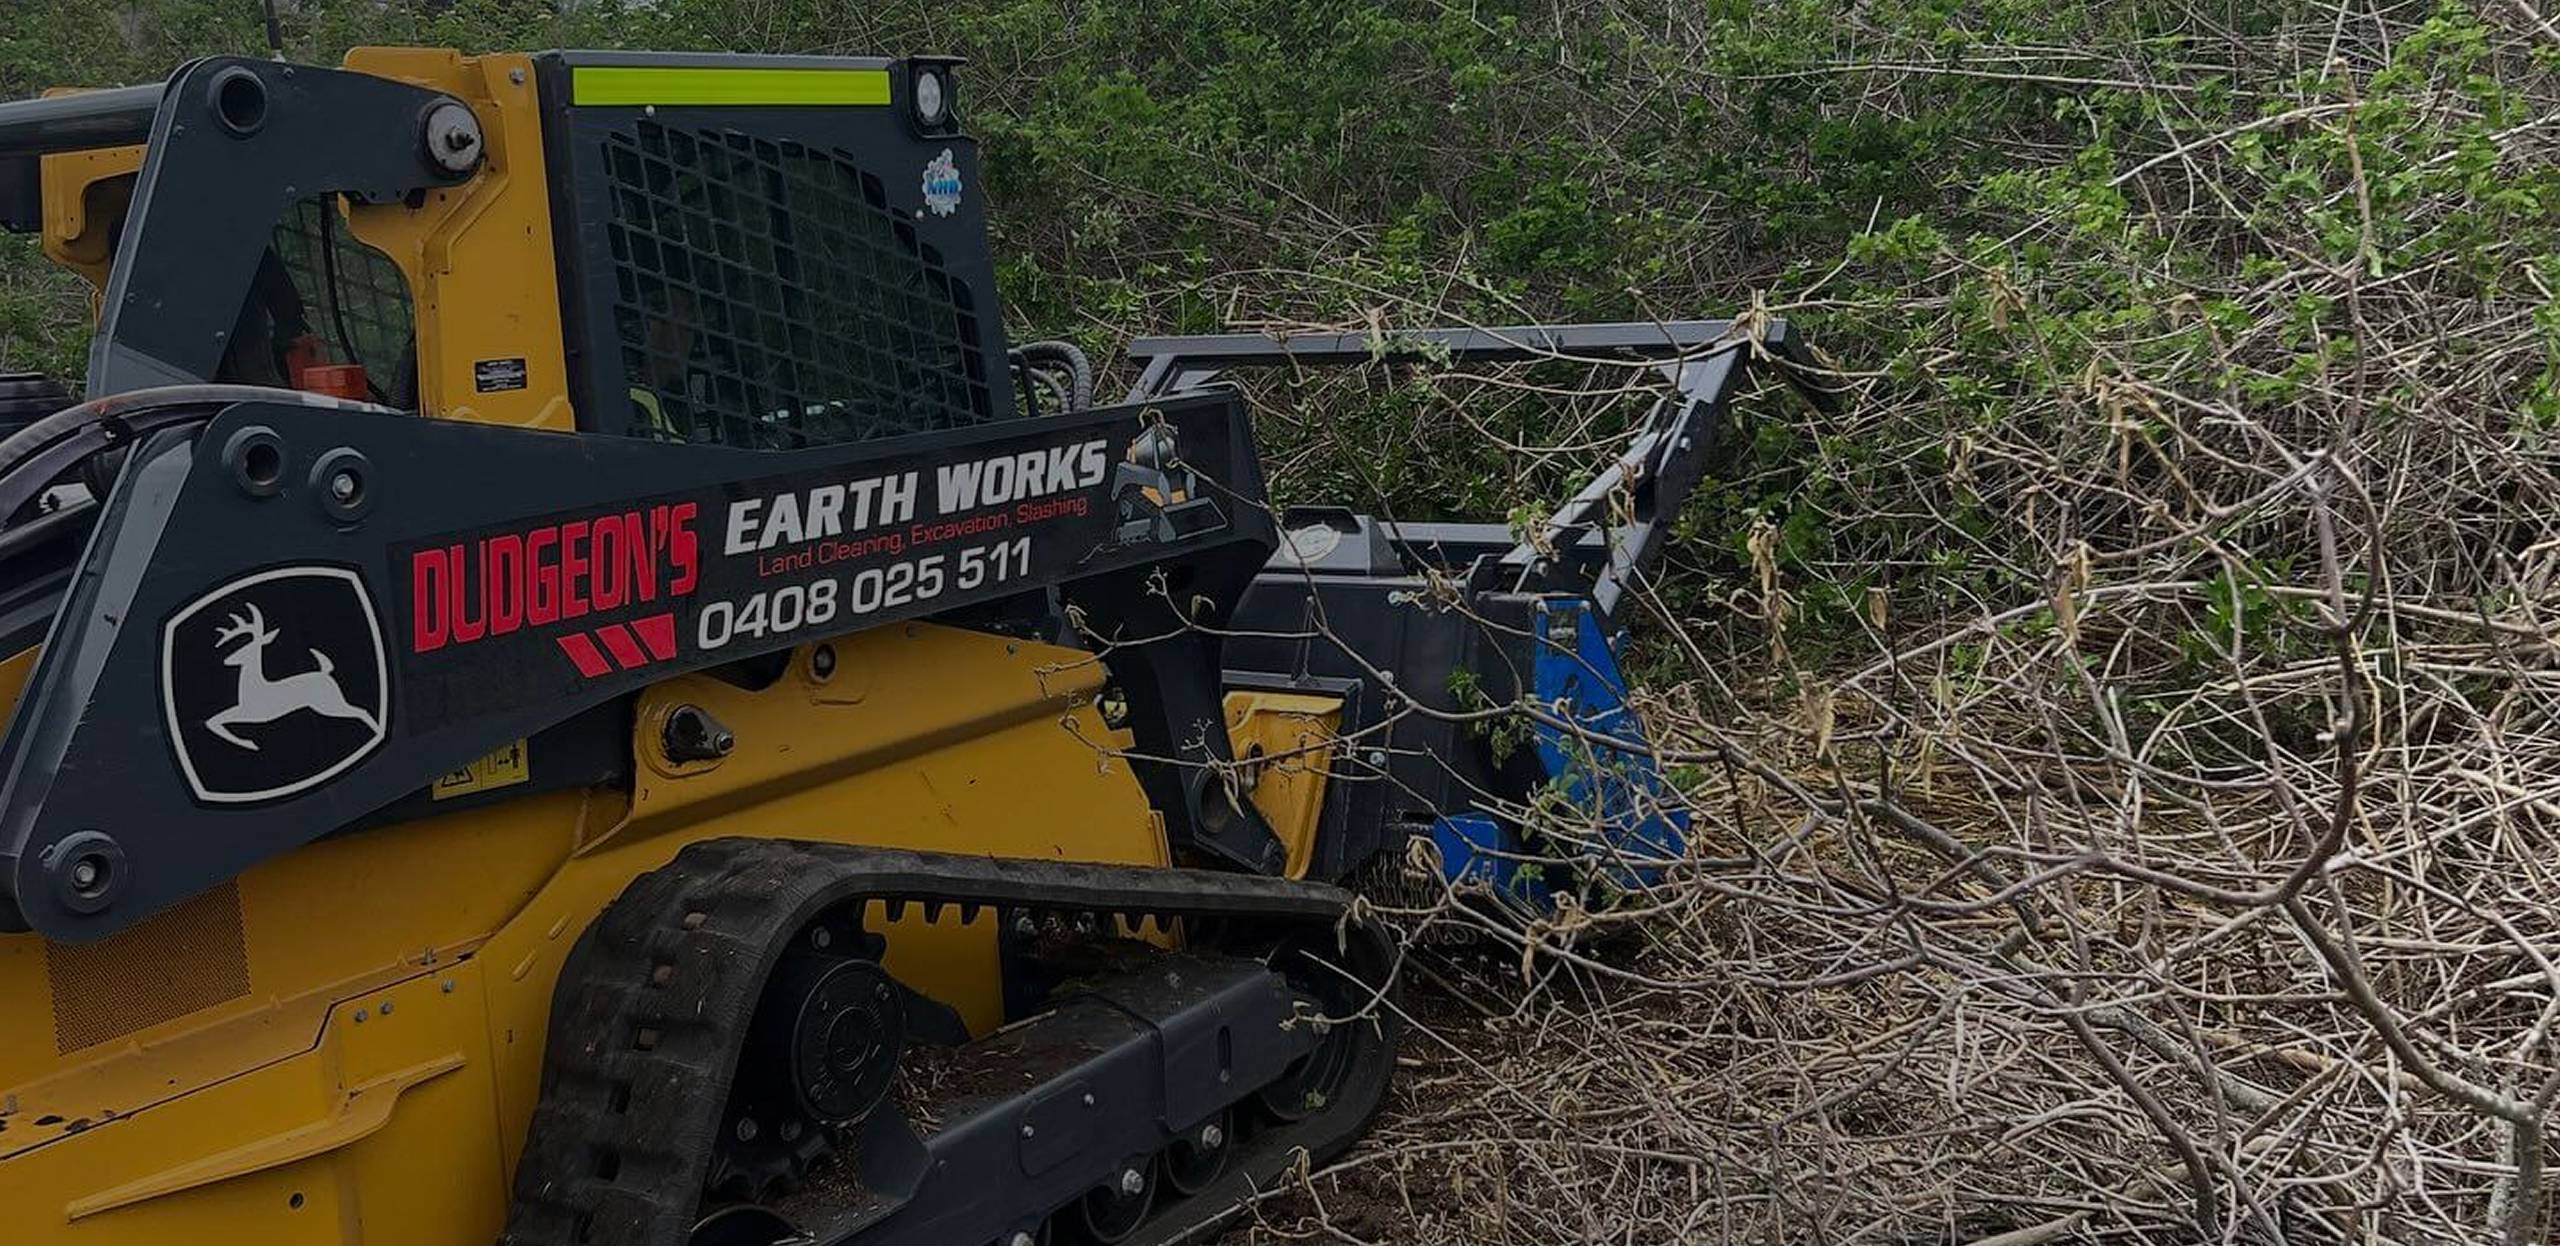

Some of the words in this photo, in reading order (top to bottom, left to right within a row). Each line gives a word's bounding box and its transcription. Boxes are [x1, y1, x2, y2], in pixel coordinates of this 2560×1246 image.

[724, 472, 919, 556] EARTH
[936, 438, 1108, 515] WORKS
[758, 545, 813, 577] Land
[911, 509, 1012, 545] Excavation,
[1016, 495, 1088, 525] Slashing
[413, 502, 697, 652] DUDGEON'S
[697, 578, 838, 650] 0408
[851, 555, 945, 615] 025
[957, 535, 1031, 590] 511
